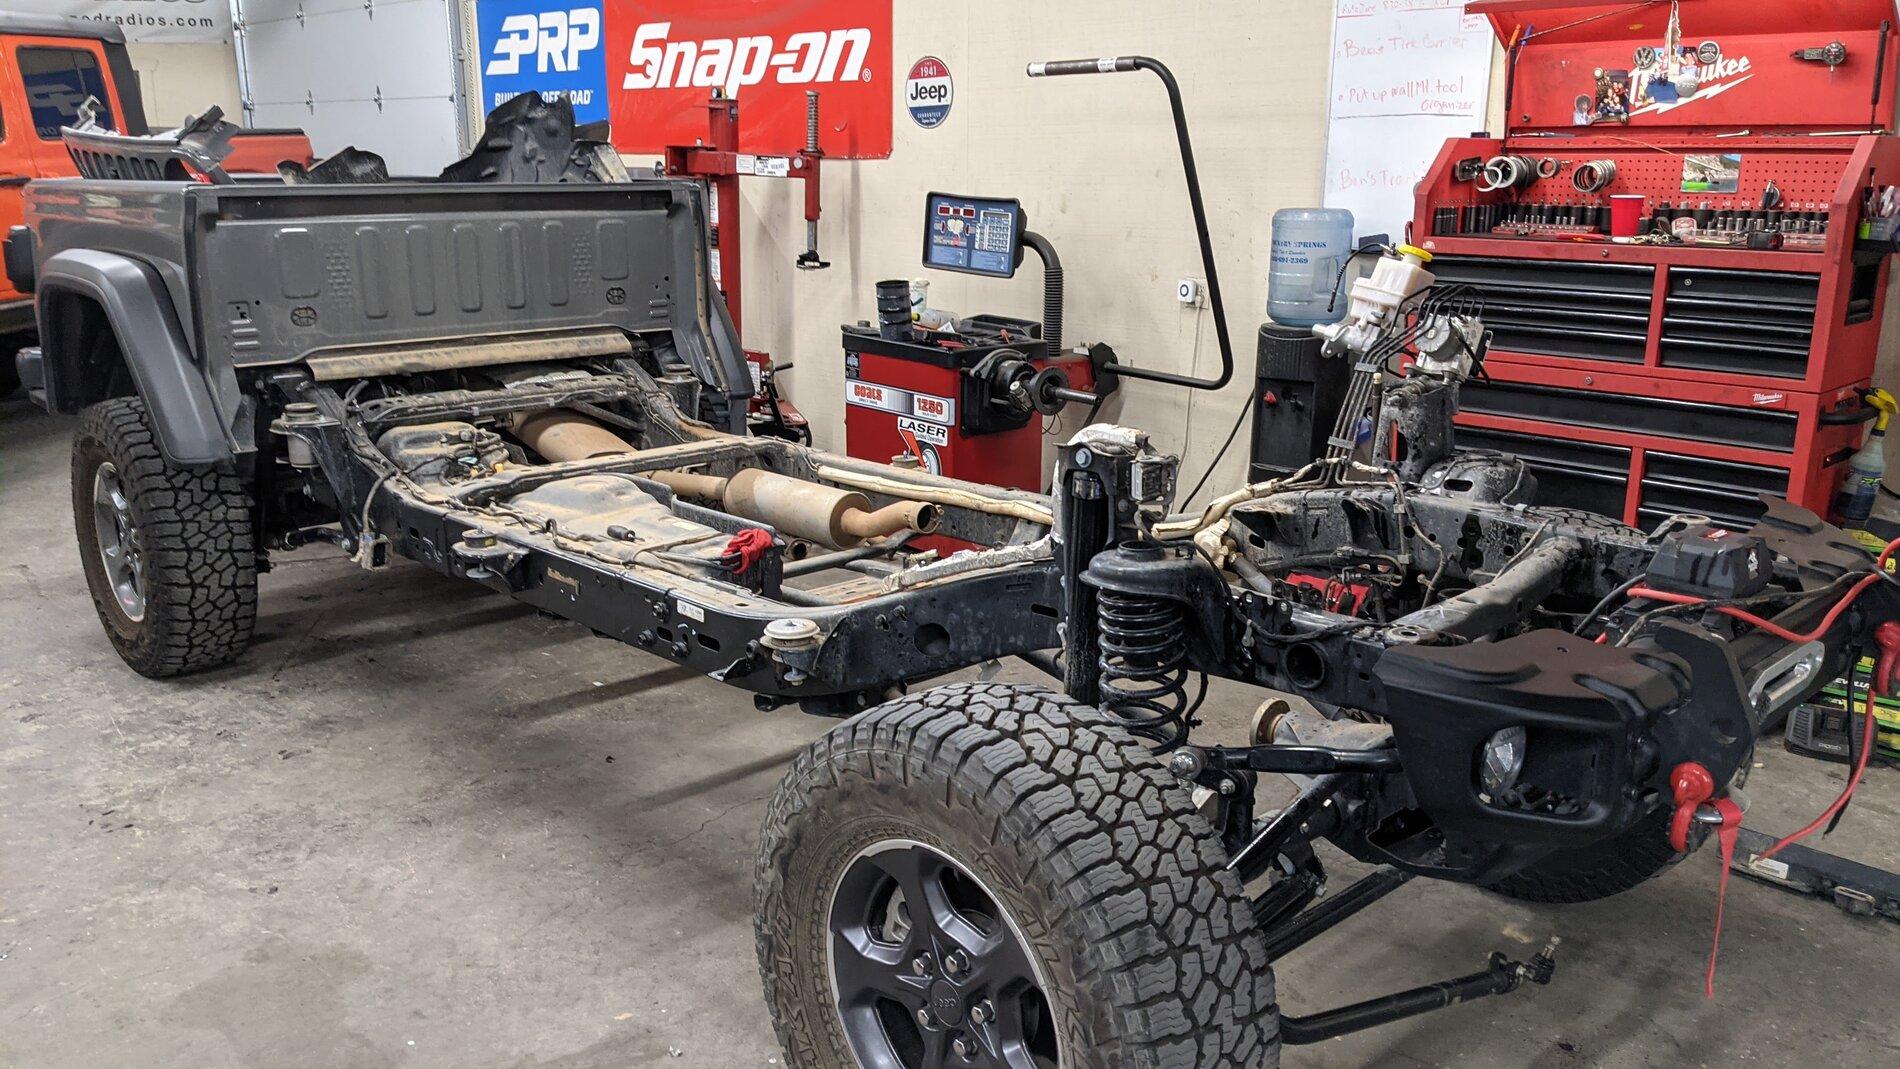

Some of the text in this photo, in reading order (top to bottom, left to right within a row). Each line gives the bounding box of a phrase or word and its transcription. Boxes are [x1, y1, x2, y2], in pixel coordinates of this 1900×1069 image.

[485, 7, 600, 76] PRP
[920, 66, 937, 77] 1941
[910, 82, 948, 103] Jeep
[1349, 88, 1368, 102] Put
[1373, 91, 1387, 101] up
[1436, 75, 1463, 93] tool
[899, 419, 946, 438] LASER
